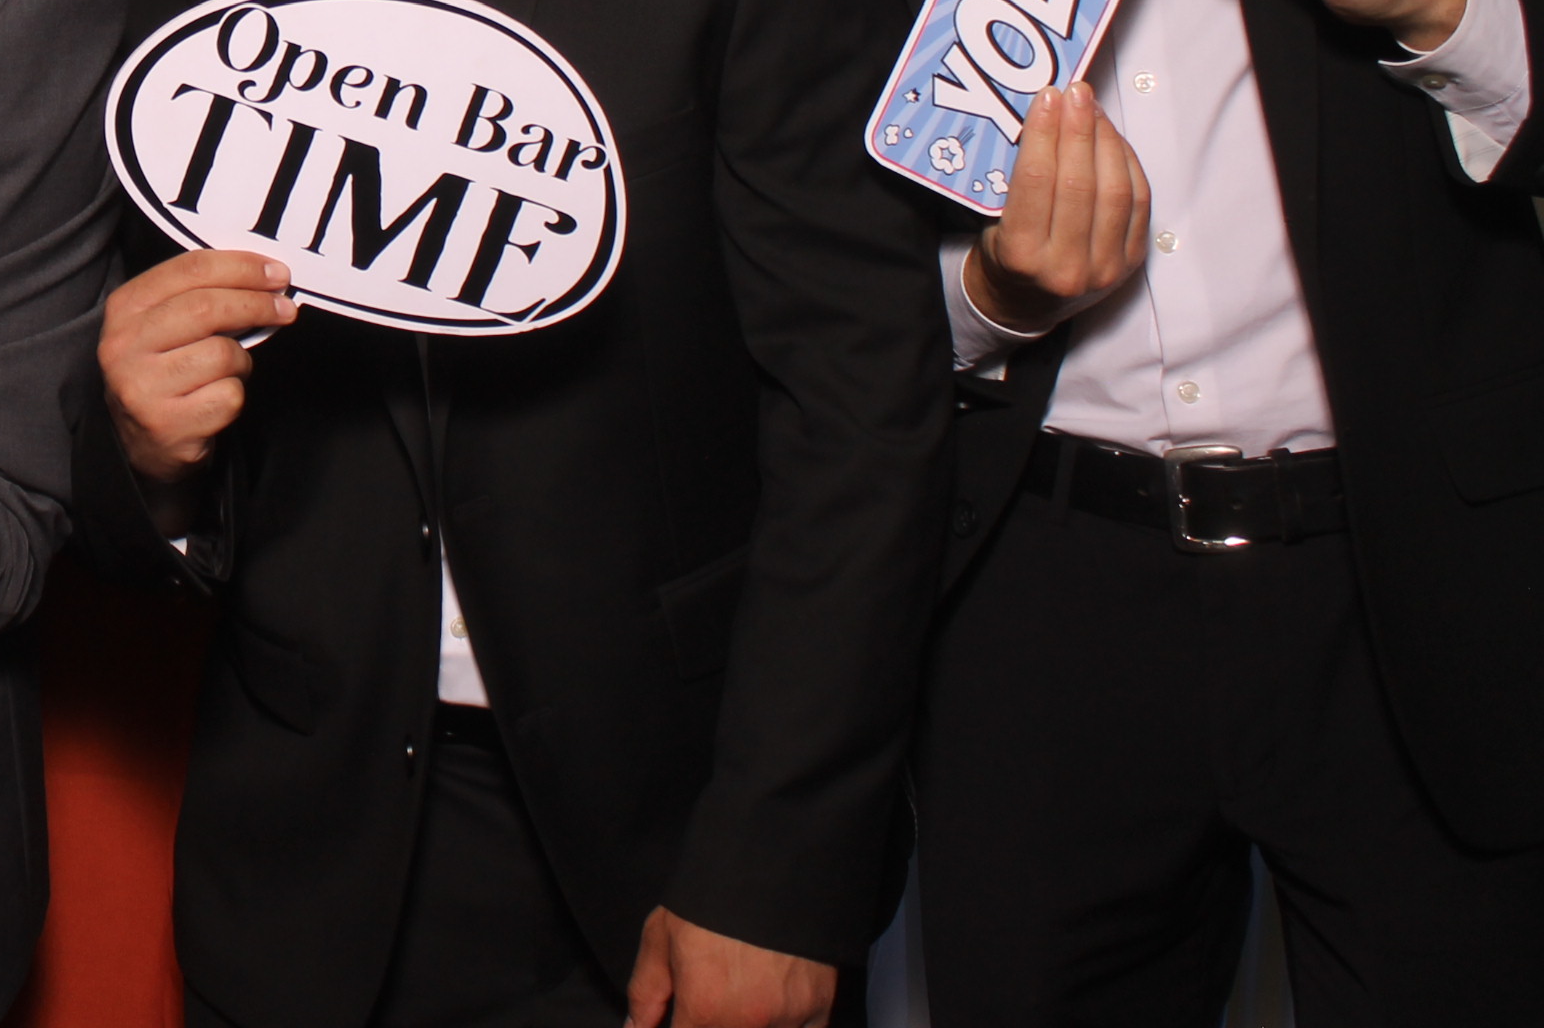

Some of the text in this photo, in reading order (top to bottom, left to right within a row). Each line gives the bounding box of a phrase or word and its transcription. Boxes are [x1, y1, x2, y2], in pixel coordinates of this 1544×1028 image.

[217, 6, 607, 182] Open Bar
[167, 82, 578, 322] TIME
